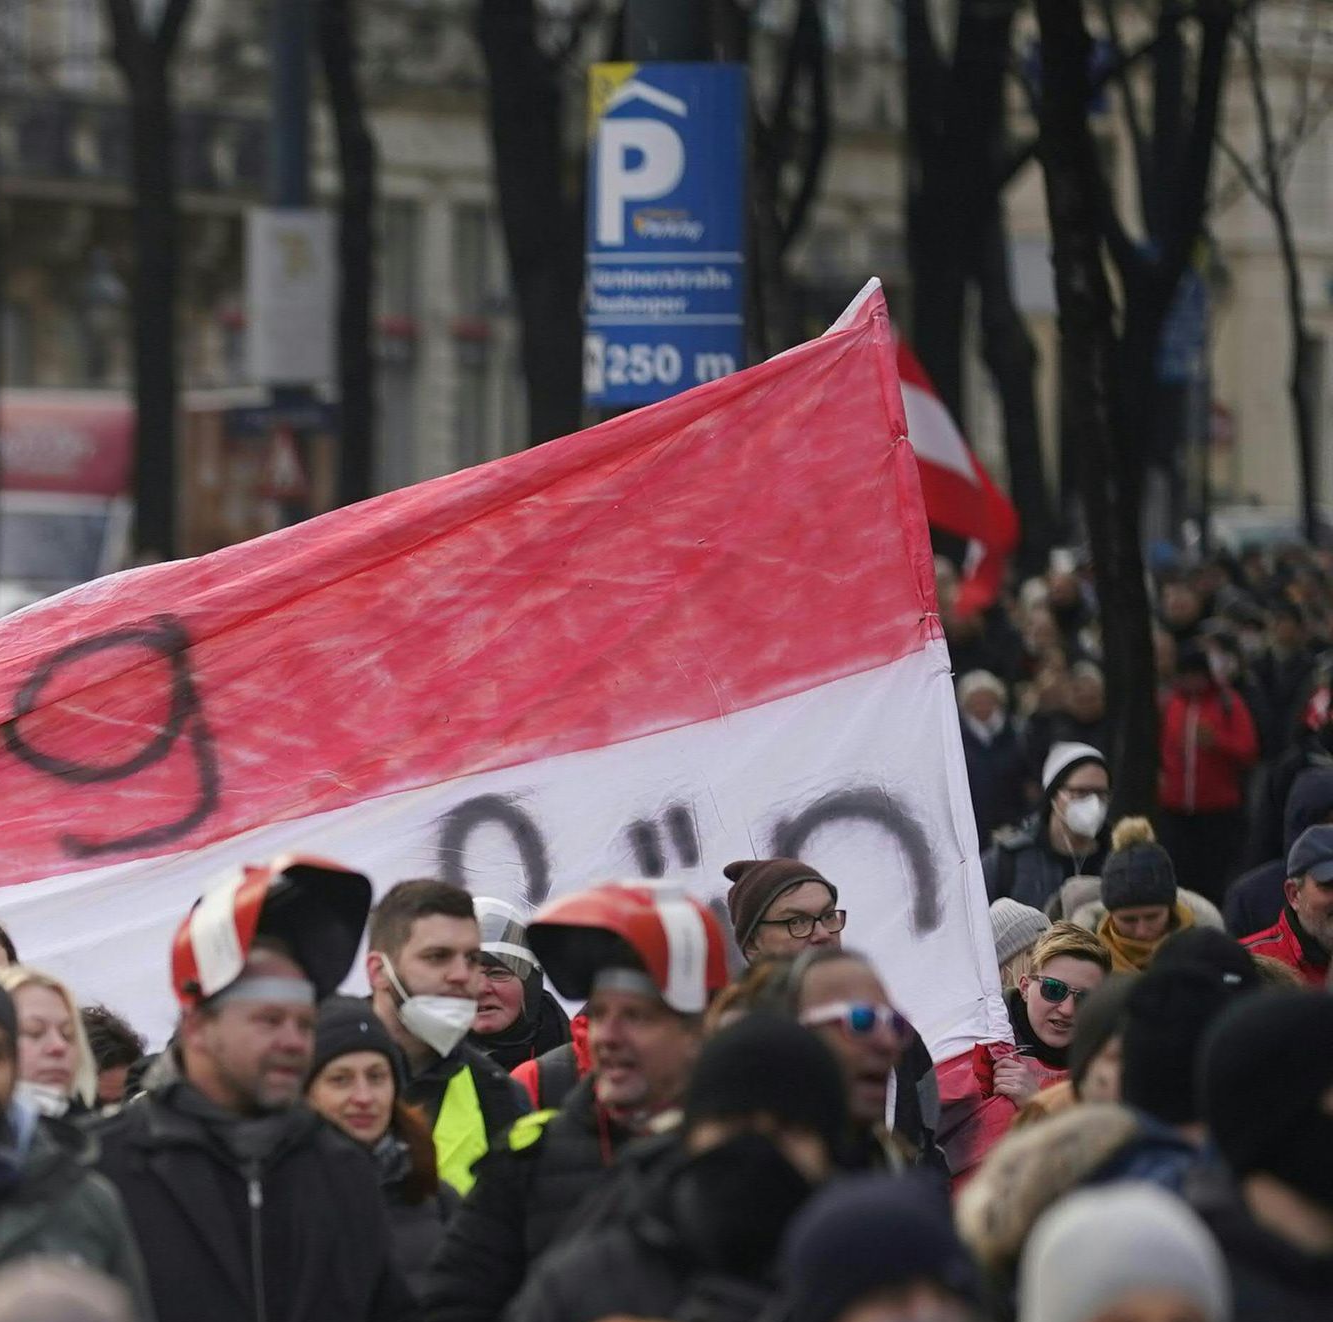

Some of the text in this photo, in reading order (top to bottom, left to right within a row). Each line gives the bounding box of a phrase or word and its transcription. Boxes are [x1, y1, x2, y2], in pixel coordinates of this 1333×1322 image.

[596, 118, 686, 247] P
[605, 343, 737, 386] 250 m
